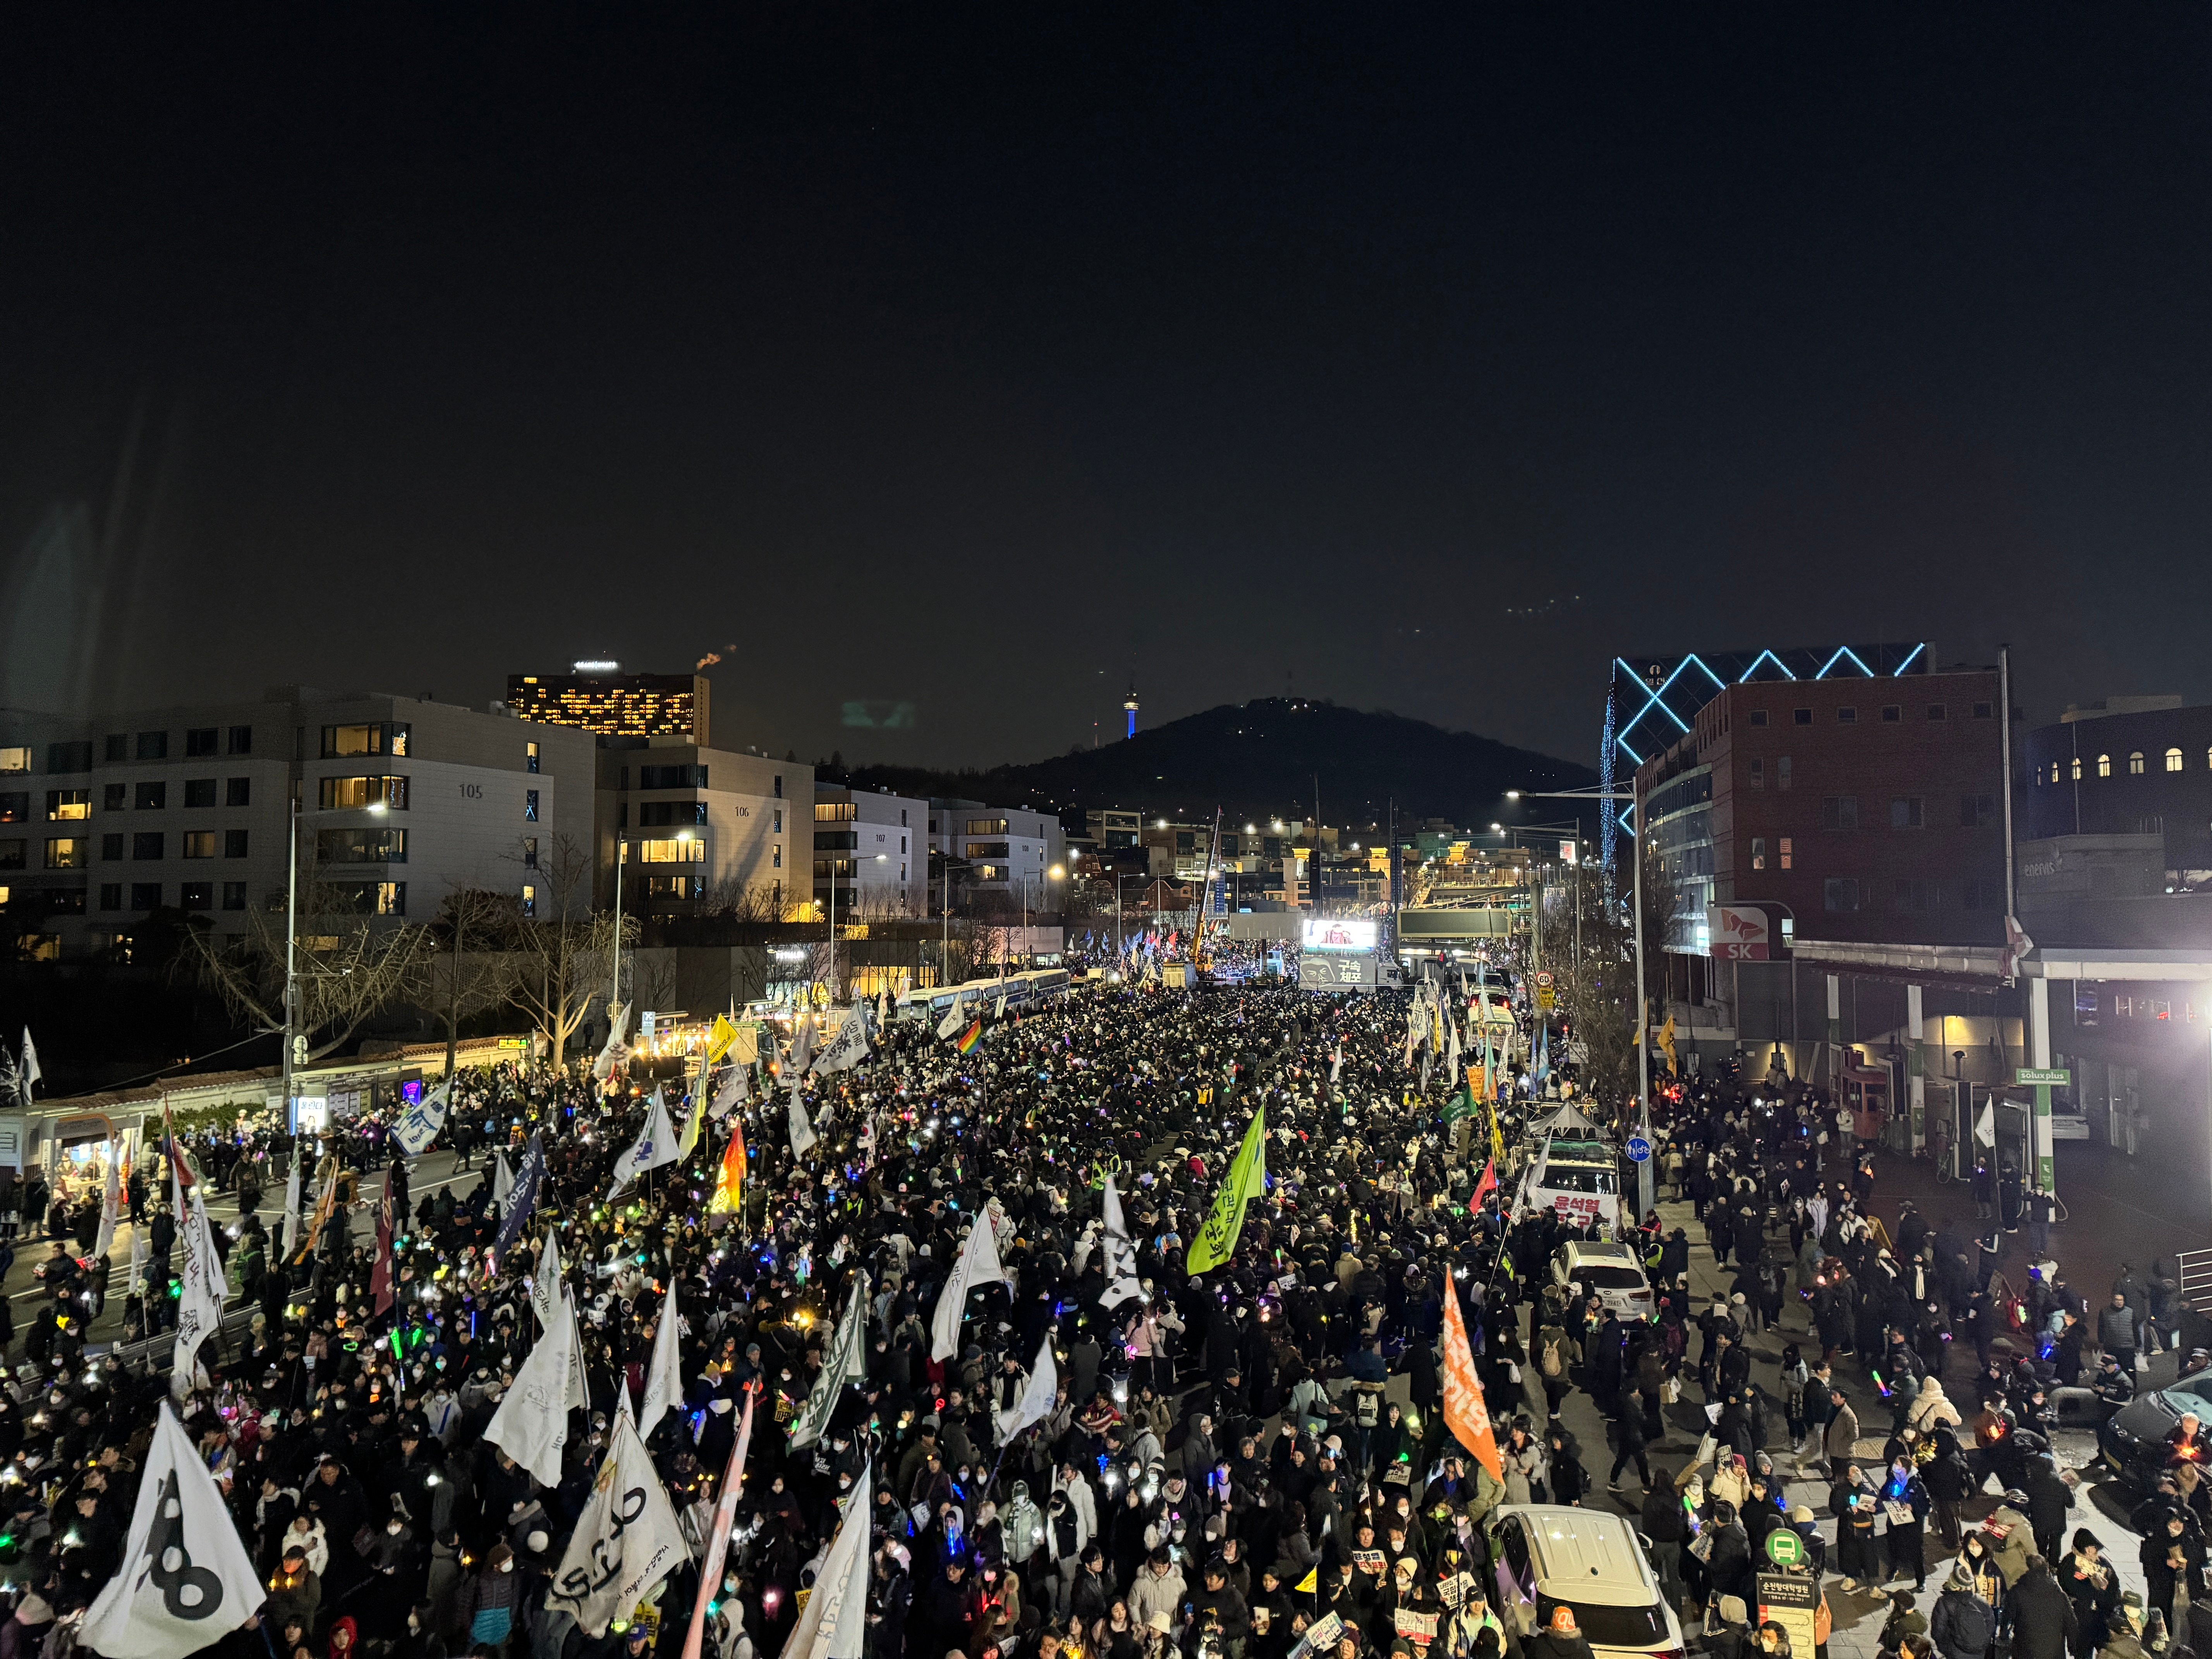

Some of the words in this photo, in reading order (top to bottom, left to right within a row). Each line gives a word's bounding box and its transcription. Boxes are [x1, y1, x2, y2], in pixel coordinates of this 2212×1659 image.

[460, 784, 483, 799] 105
[735, 807, 749, 817] 106
[876, 834, 885, 843] 107
[1728, 944, 1752, 959] SK
[1338, 959, 1361, 972] 구속
[1340, 972, 1362, 983] 체포
[2046, 1072, 2064, 1080] plus
[1554, 1195, 1601, 1213] 윤석열
[1763, 1582, 1808, 1594] 순천향대학병원
